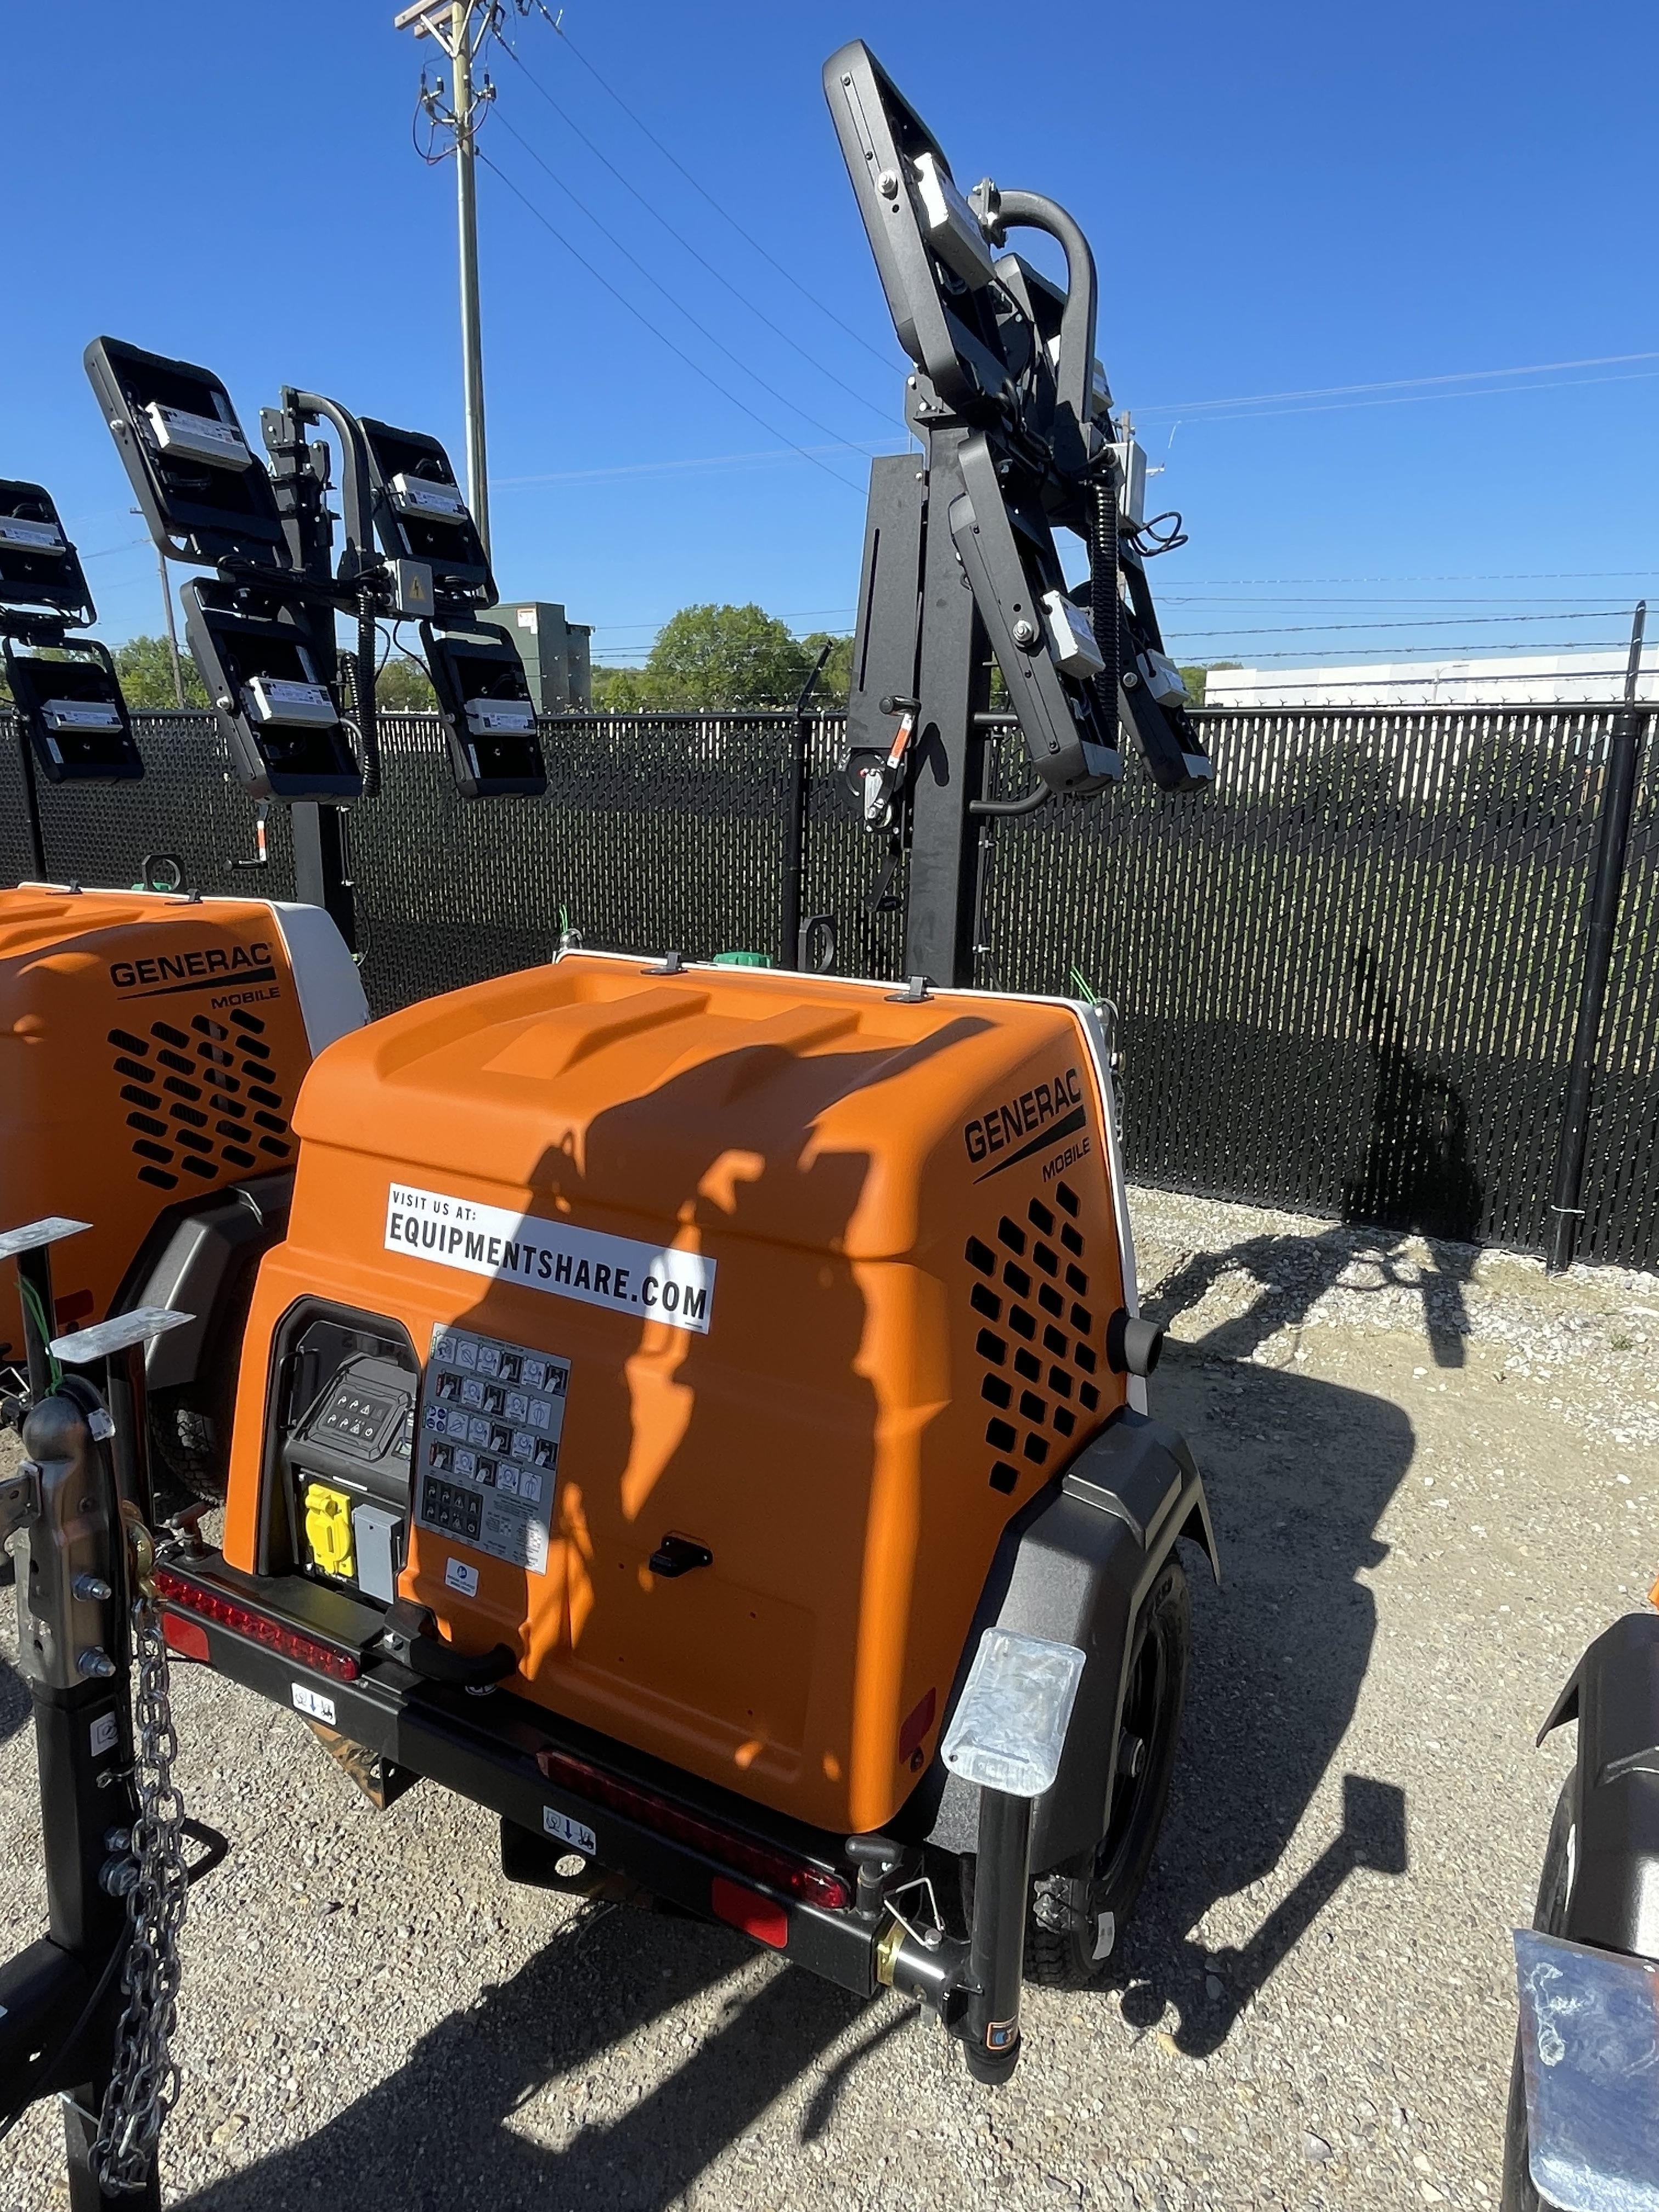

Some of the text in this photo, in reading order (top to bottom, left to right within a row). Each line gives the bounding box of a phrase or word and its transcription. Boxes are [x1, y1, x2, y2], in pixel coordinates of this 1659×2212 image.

[110, 943, 272, 987] GENERAC
[211, 987, 280, 1009] MOBILE
[964, 1068, 1081, 1163] GENERAC
[1042, 1137, 1091, 1182] MOBILE
[393, 1190, 476, 1221] VISIT US AT:
[390, 1212, 707, 1320] EQUIPMENTSHARE.COM
